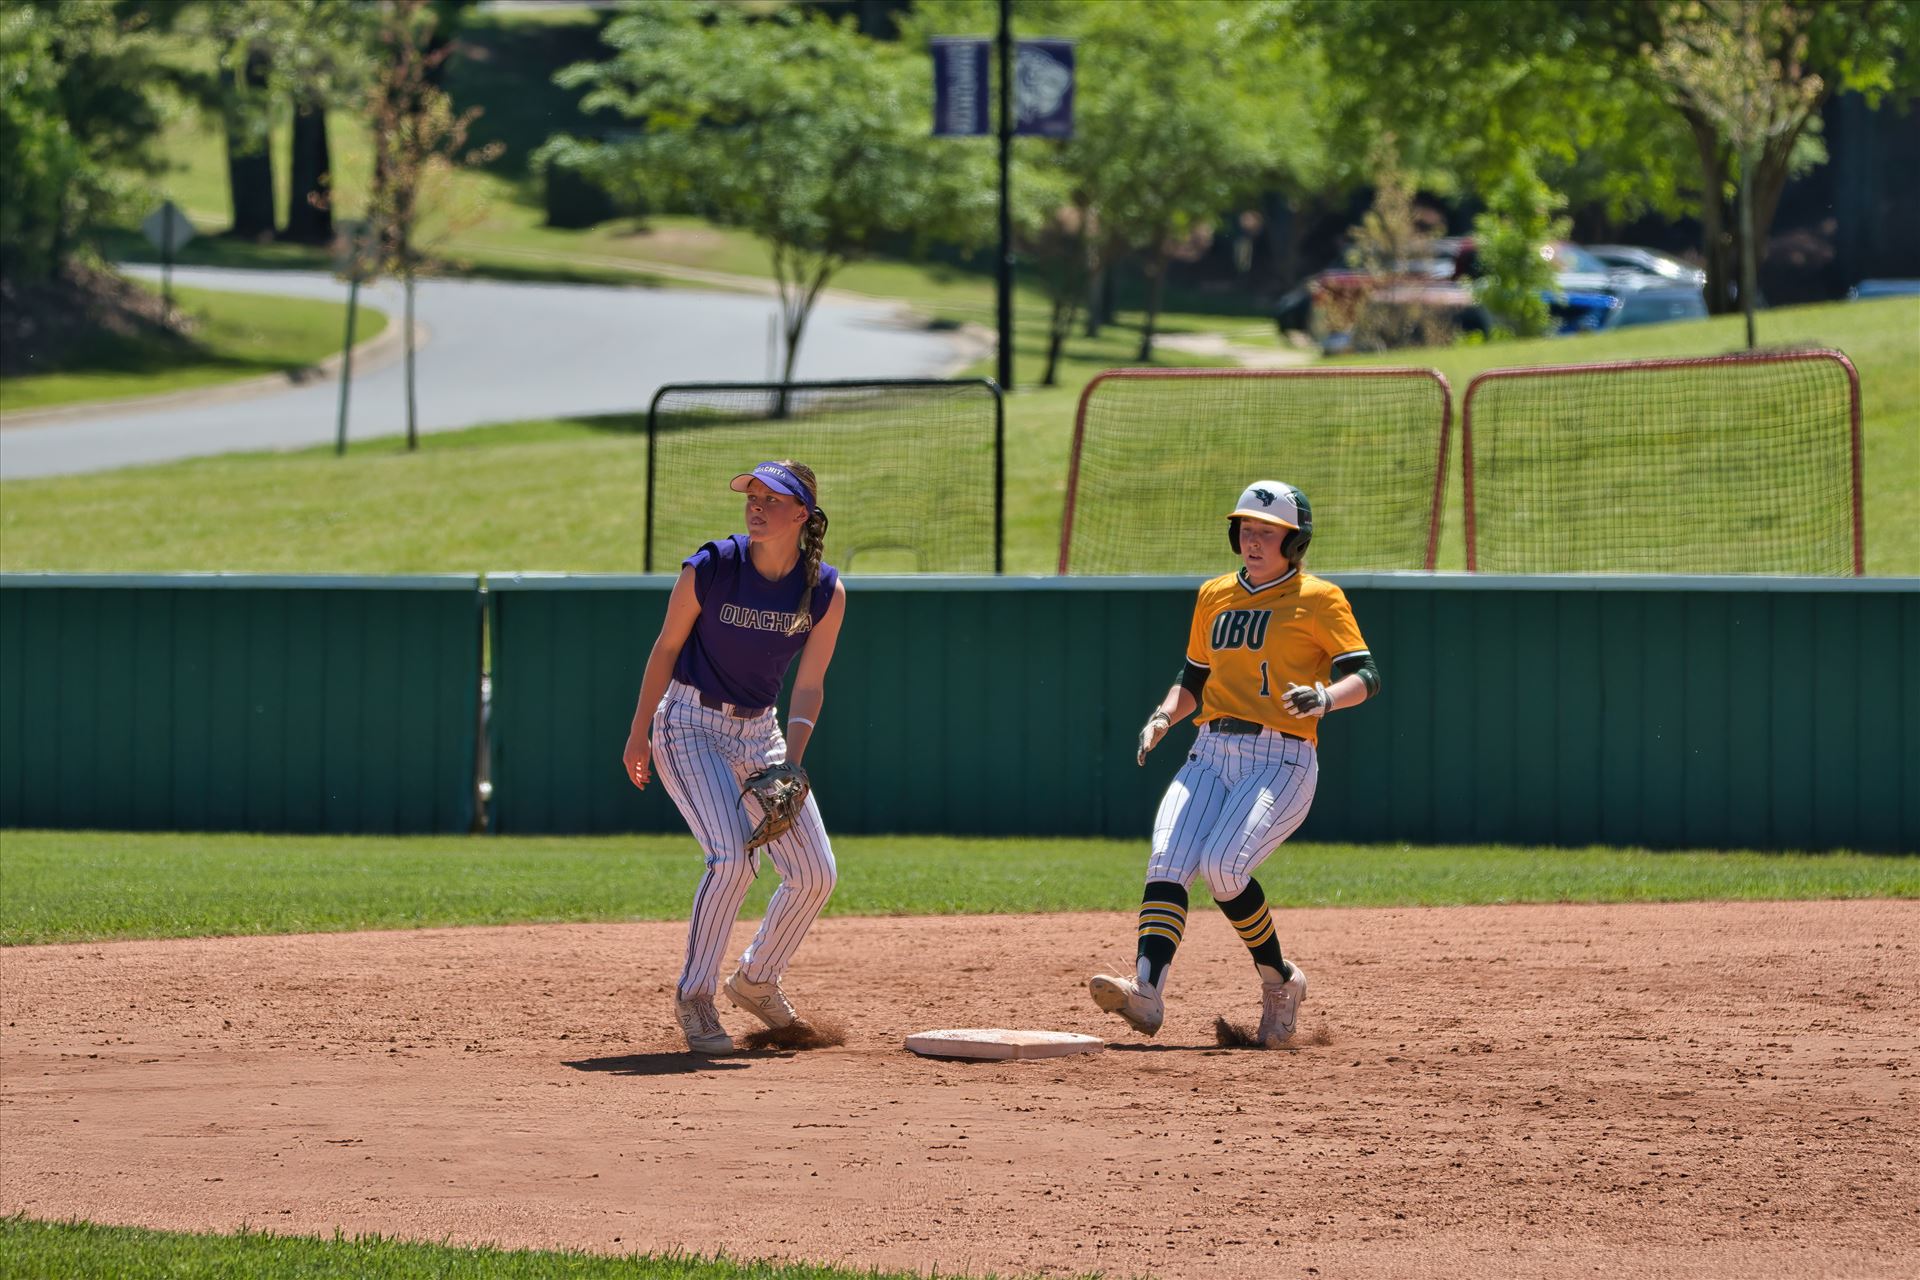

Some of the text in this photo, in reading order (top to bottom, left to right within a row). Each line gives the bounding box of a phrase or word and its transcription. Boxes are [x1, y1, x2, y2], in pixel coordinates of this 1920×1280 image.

[720, 604, 812, 632] OUACHIA
[1211, 609, 1272, 651] OBU
[1260, 661, 1269, 696] 1
